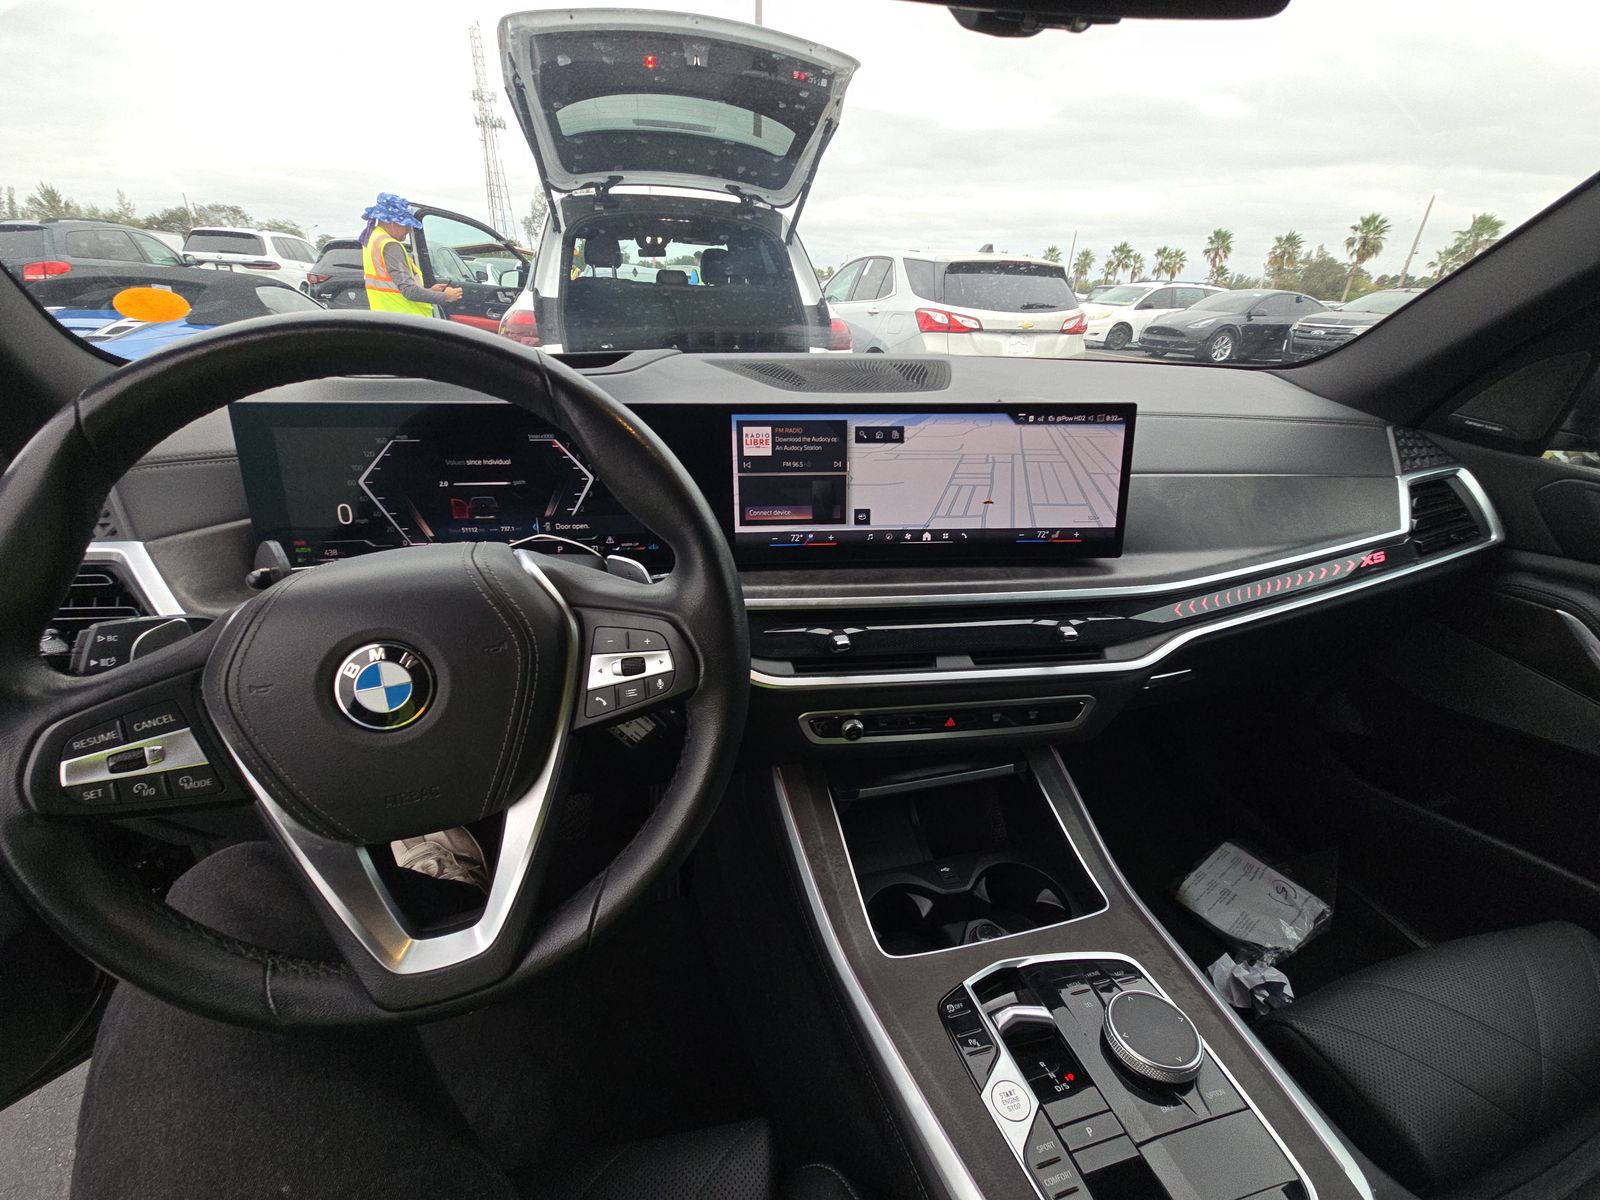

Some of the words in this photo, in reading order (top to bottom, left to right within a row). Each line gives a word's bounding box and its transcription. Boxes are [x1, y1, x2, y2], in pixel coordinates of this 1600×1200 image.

[744, 438, 770, 446] LIBRE
[465, 458, 482, 466] since
[482, 458, 512, 466] Individual
[336, 503, 354, 526] 0
[748, 509, 772, 517] Connect
[772, 509, 792, 517] device
[555, 522, 571, 530] Door
[557, 545, 564, 553] P
[1359, 549, 1386, 568] X5
[106, 634, 119, 642] BC
[342, 647, 419, 679] BMW
[132, 713, 176, 732] CANCEL
[71, 729, 120, 751] RESUME
[184, 777, 213, 790] MODE
[81, 787, 104, 801] SET
[1053, 1081, 1071, 1093] D/S
[998, 1088, 1017, 1099] START
[1006, 1102, 1022, 1113] STOP
[1085, 1126, 1094, 1138] P
[1035, 1140, 1056, 1154] SPORT
[1043, 1170, 1073, 1187] COMFORT
